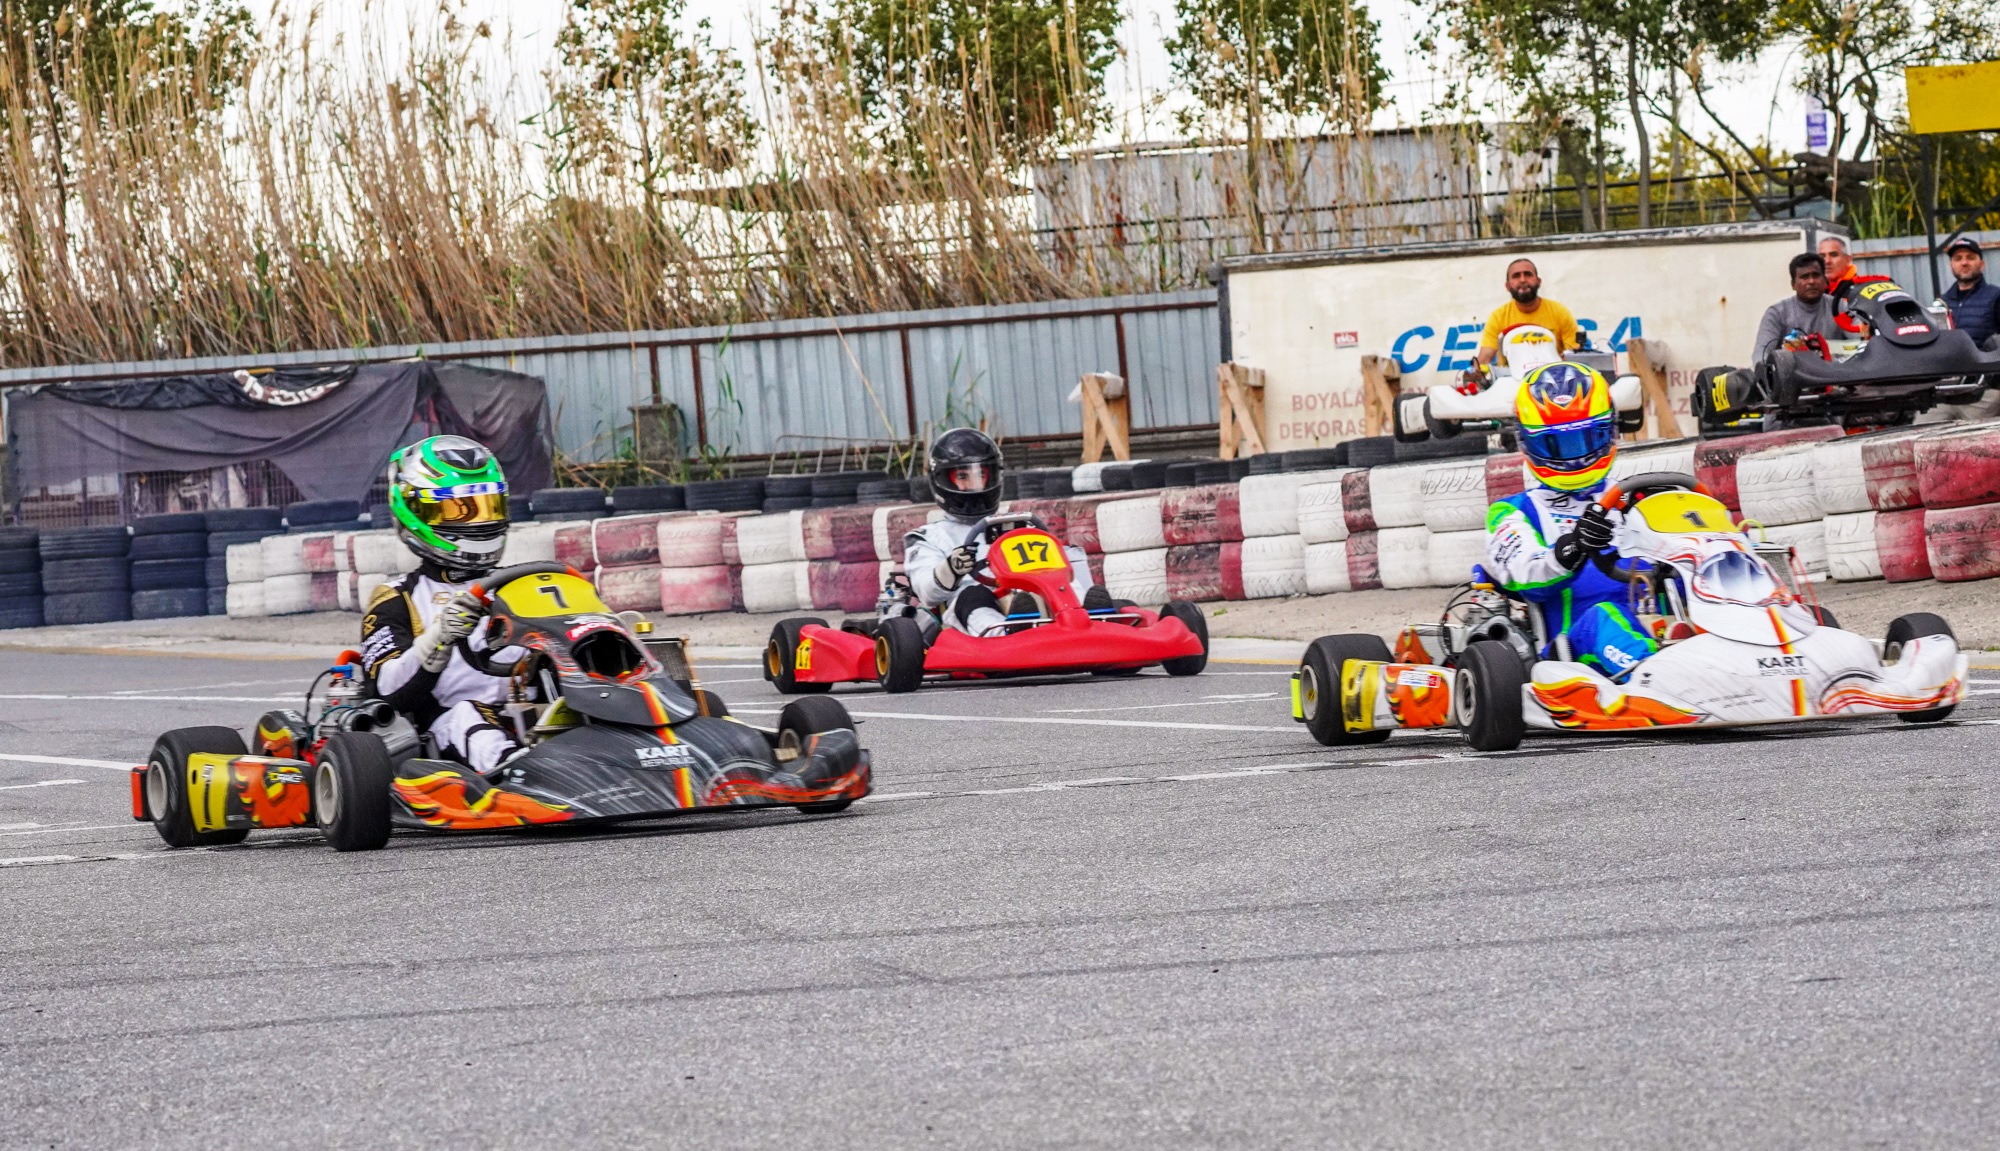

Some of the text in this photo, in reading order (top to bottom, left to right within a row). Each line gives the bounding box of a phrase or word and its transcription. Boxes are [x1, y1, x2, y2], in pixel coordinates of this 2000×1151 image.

[1291, 389, 1369, 411] BOYALA
[1683, 511, 1708, 528] 1
[1012, 541, 1048, 566] 17
[539, 585, 570, 608] 7
[1757, 655, 1804, 668] KART
[634, 744, 690, 760] KART
